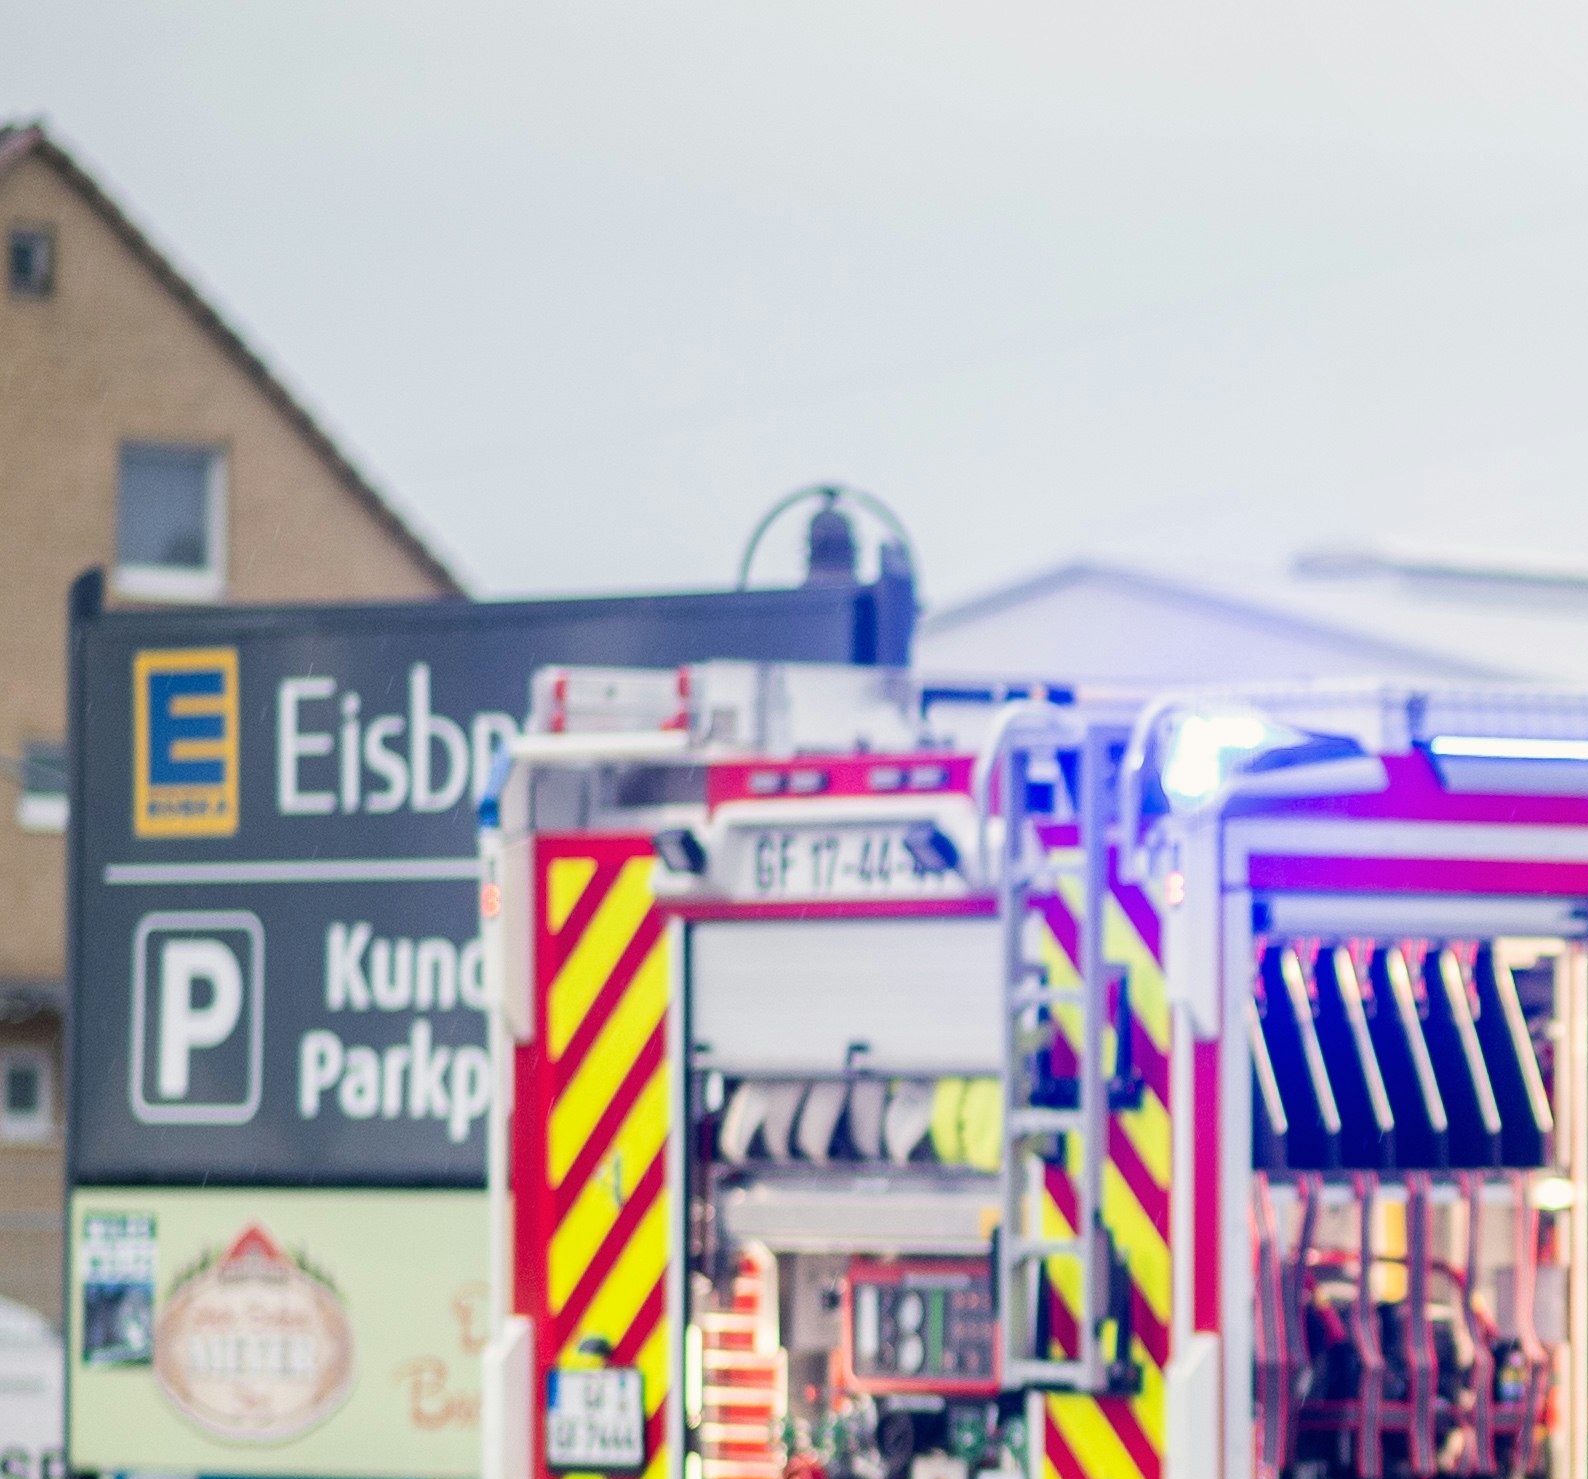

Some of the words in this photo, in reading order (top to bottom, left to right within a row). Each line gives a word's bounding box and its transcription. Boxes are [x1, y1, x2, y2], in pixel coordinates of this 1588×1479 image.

[755, 836, 795, 892] GF
[811, 836, 944, 888] 17-44-
[159, 936, 243, 1099] P
[300, 1017, 492, 1144] Parkp
